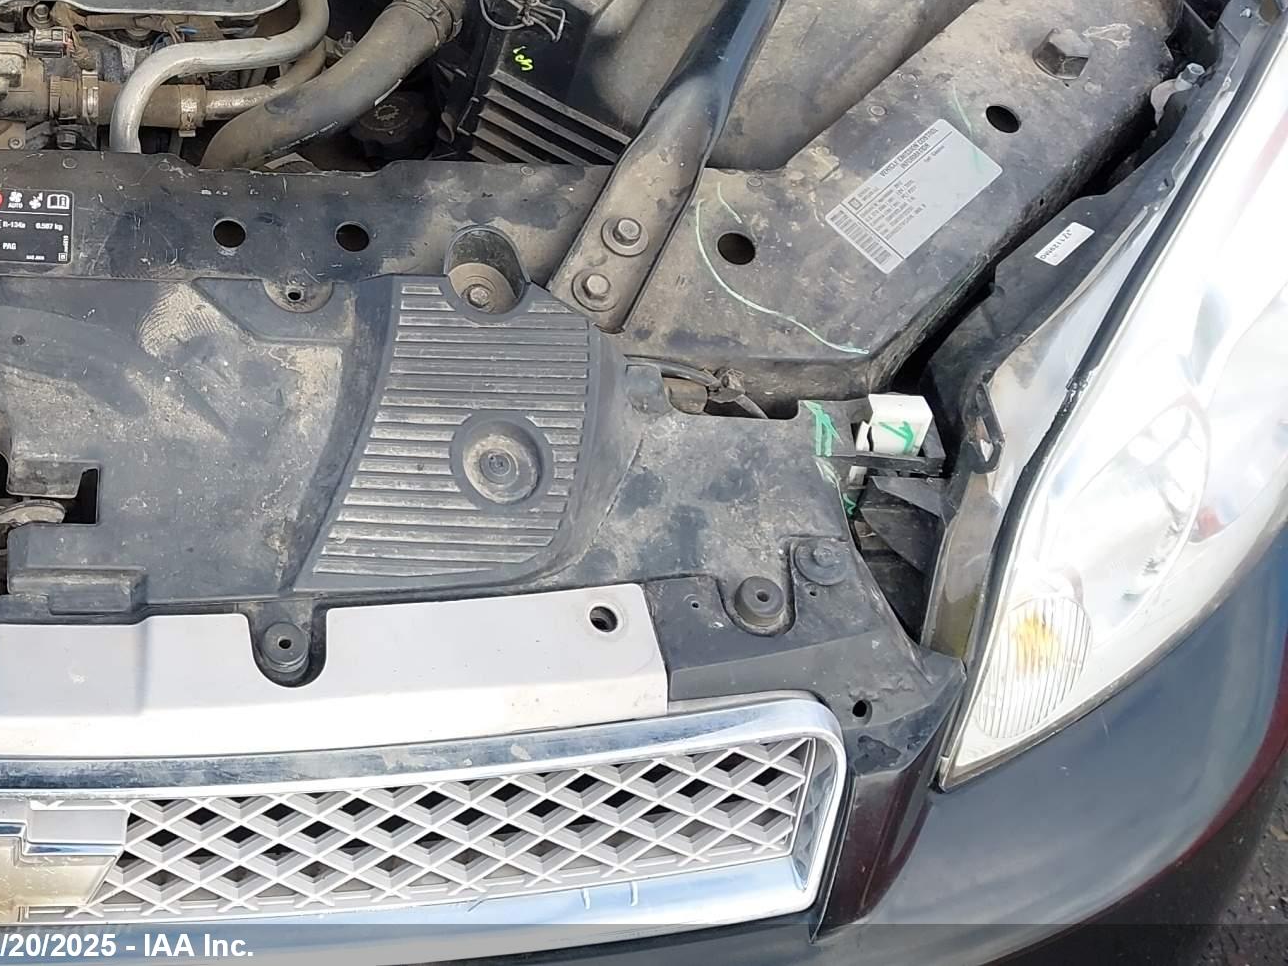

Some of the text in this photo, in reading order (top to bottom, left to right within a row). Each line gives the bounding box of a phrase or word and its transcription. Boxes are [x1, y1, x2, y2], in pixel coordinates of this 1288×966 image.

[2, 220, 26, 229] R-134a
[54, 223, 64, 231] kg
[2, 242, 17, 250] PAG
